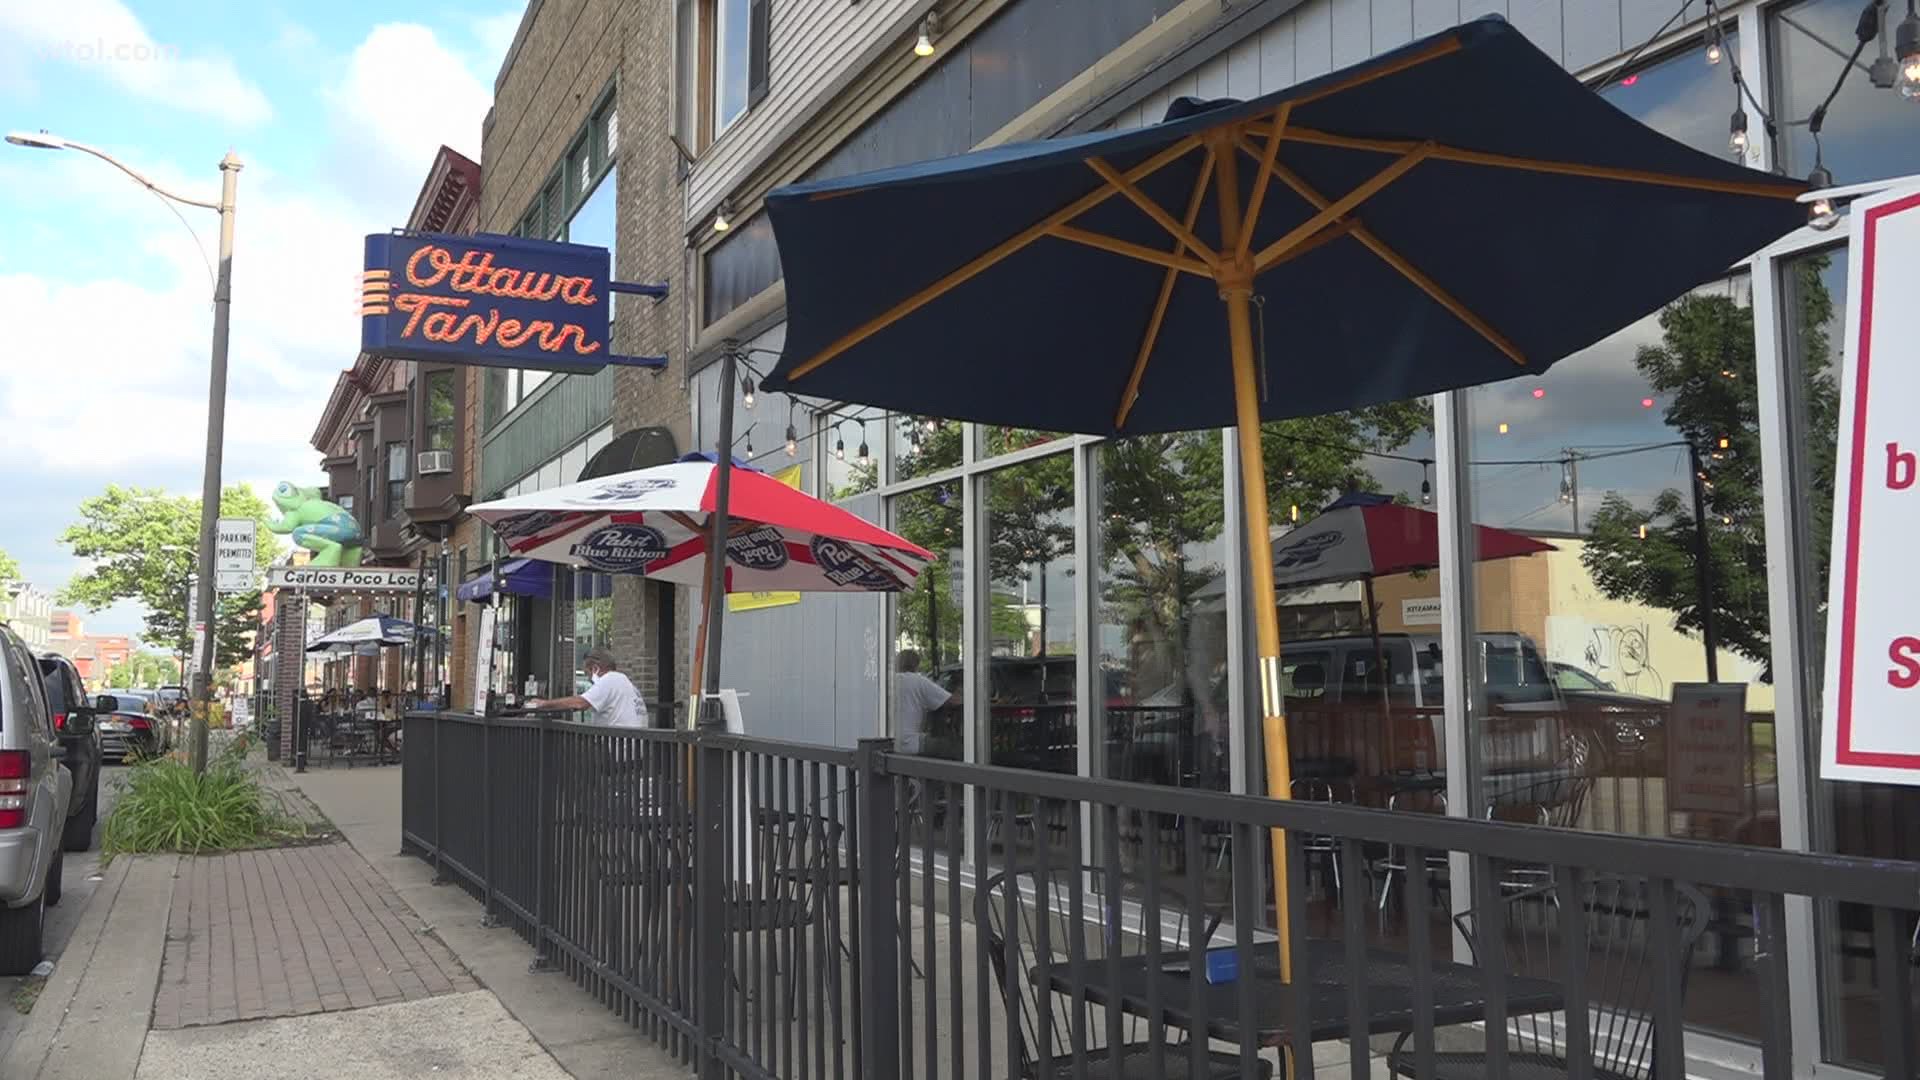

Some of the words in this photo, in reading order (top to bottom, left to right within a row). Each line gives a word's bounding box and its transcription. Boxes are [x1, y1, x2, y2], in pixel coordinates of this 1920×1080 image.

[405, 244, 598, 305] Ottawa
[394, 293, 600, 354] Tavern
[220, 533, 252, 543] PARKING
[598, 529, 652, 547] Pabst
[218, 548, 252, 559] PERMITTED
[574, 545, 609, 557] Blue
[611, 547, 667, 559] Ribbon
[284, 570, 337, 585] Carlos
[343, 572, 382, 586] Poco
[388, 572, 424, 586] Loc
